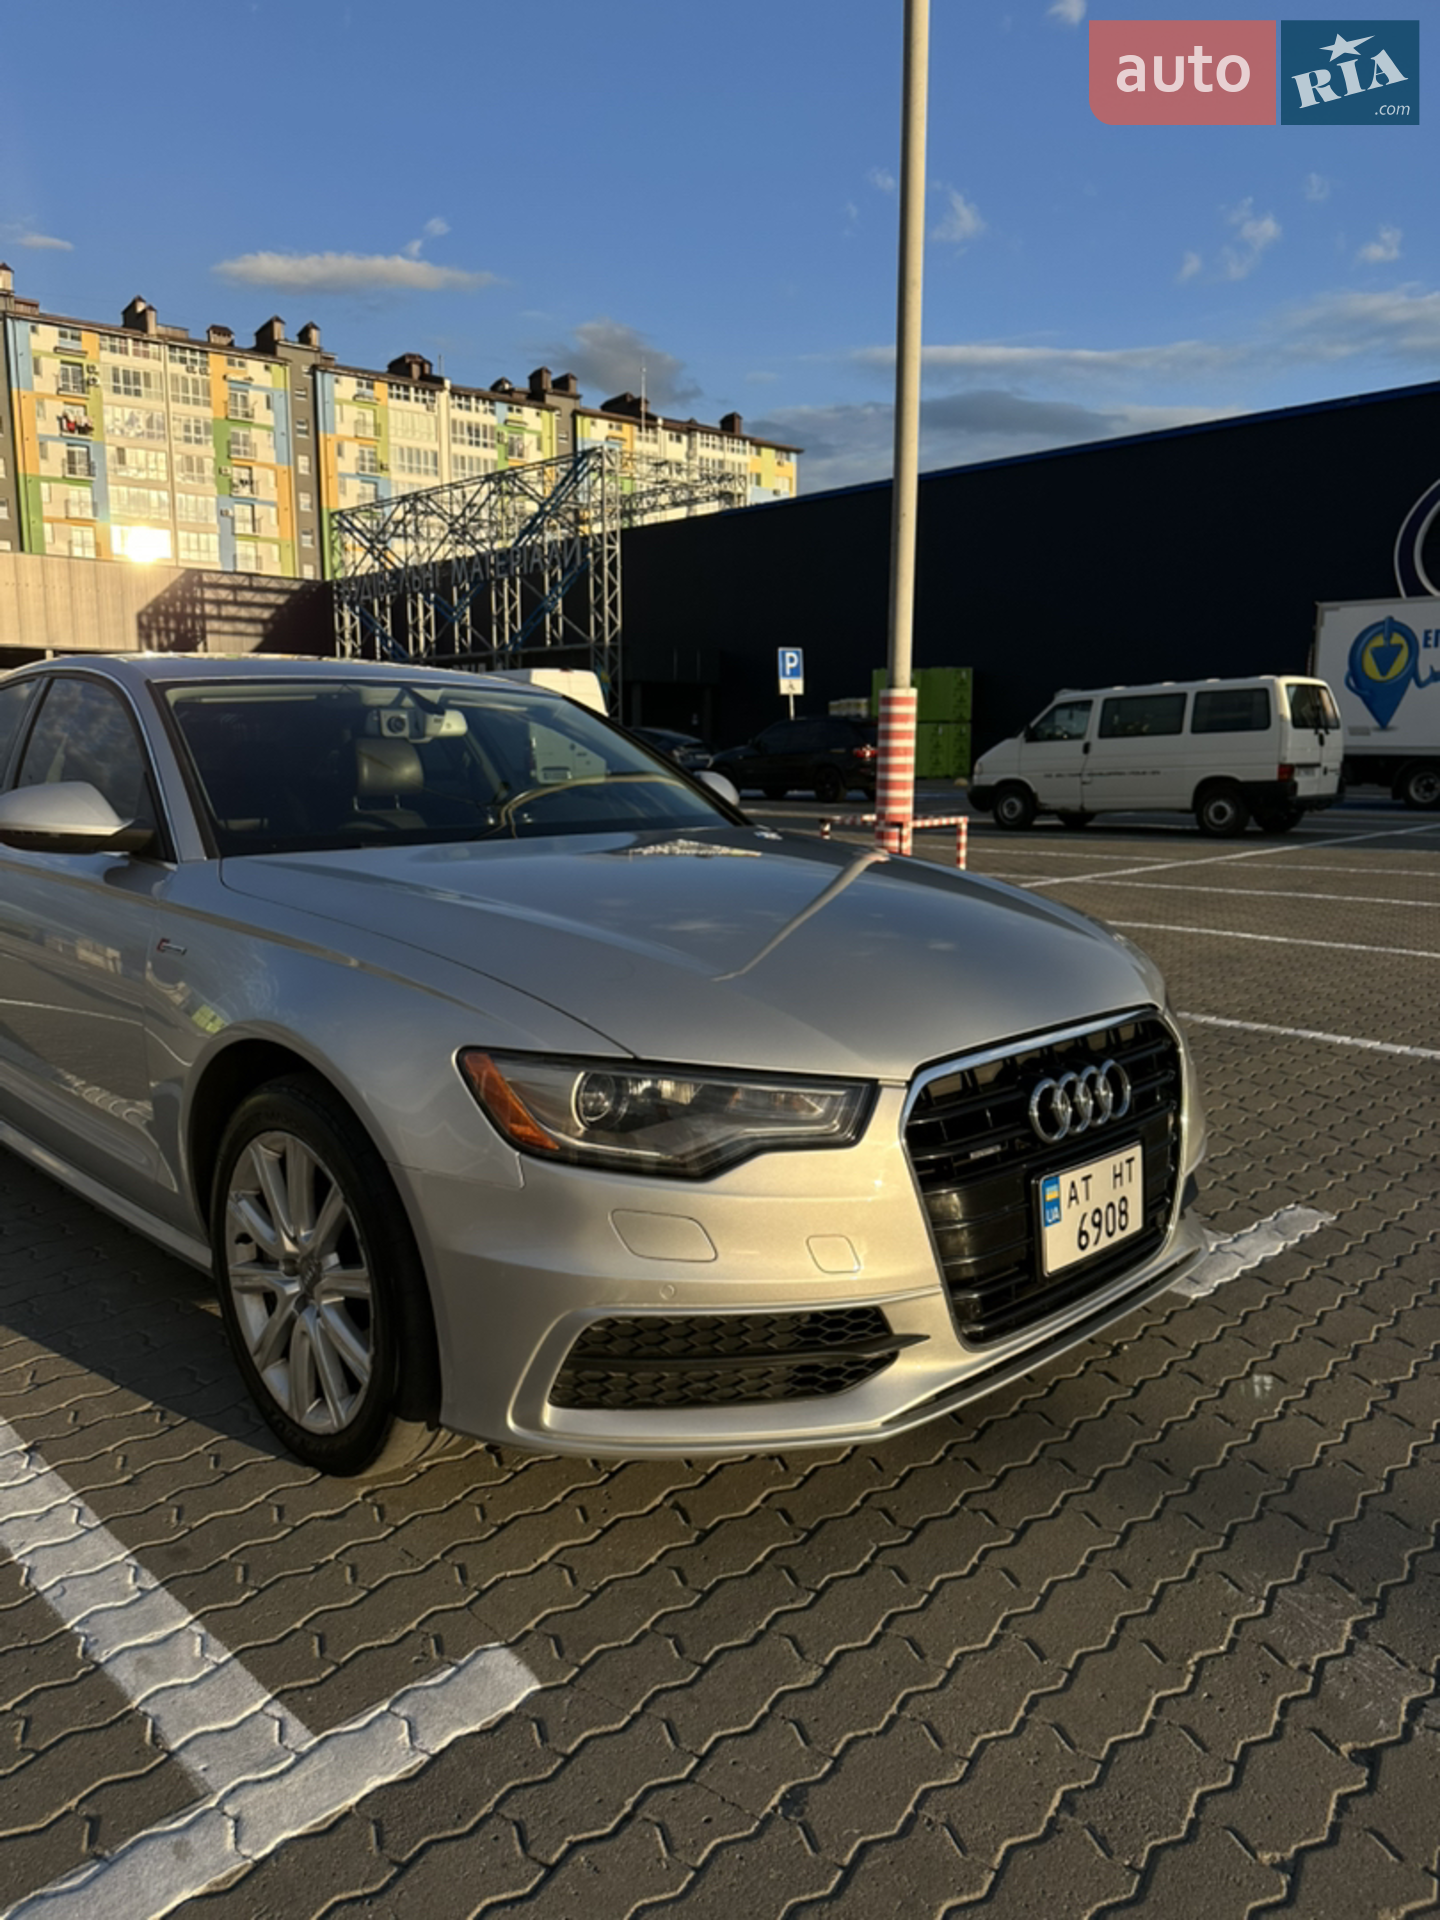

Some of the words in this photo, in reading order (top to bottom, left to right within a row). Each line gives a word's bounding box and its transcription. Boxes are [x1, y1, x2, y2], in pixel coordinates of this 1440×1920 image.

[785, 651, 799, 676] P
[1067, 1174, 1092, 1209] AT
[1112, 1156, 1135, 1189] HT
[1045, 1206, 1060, 1223] UA
[1077, 1195, 1129, 1251] 6908
